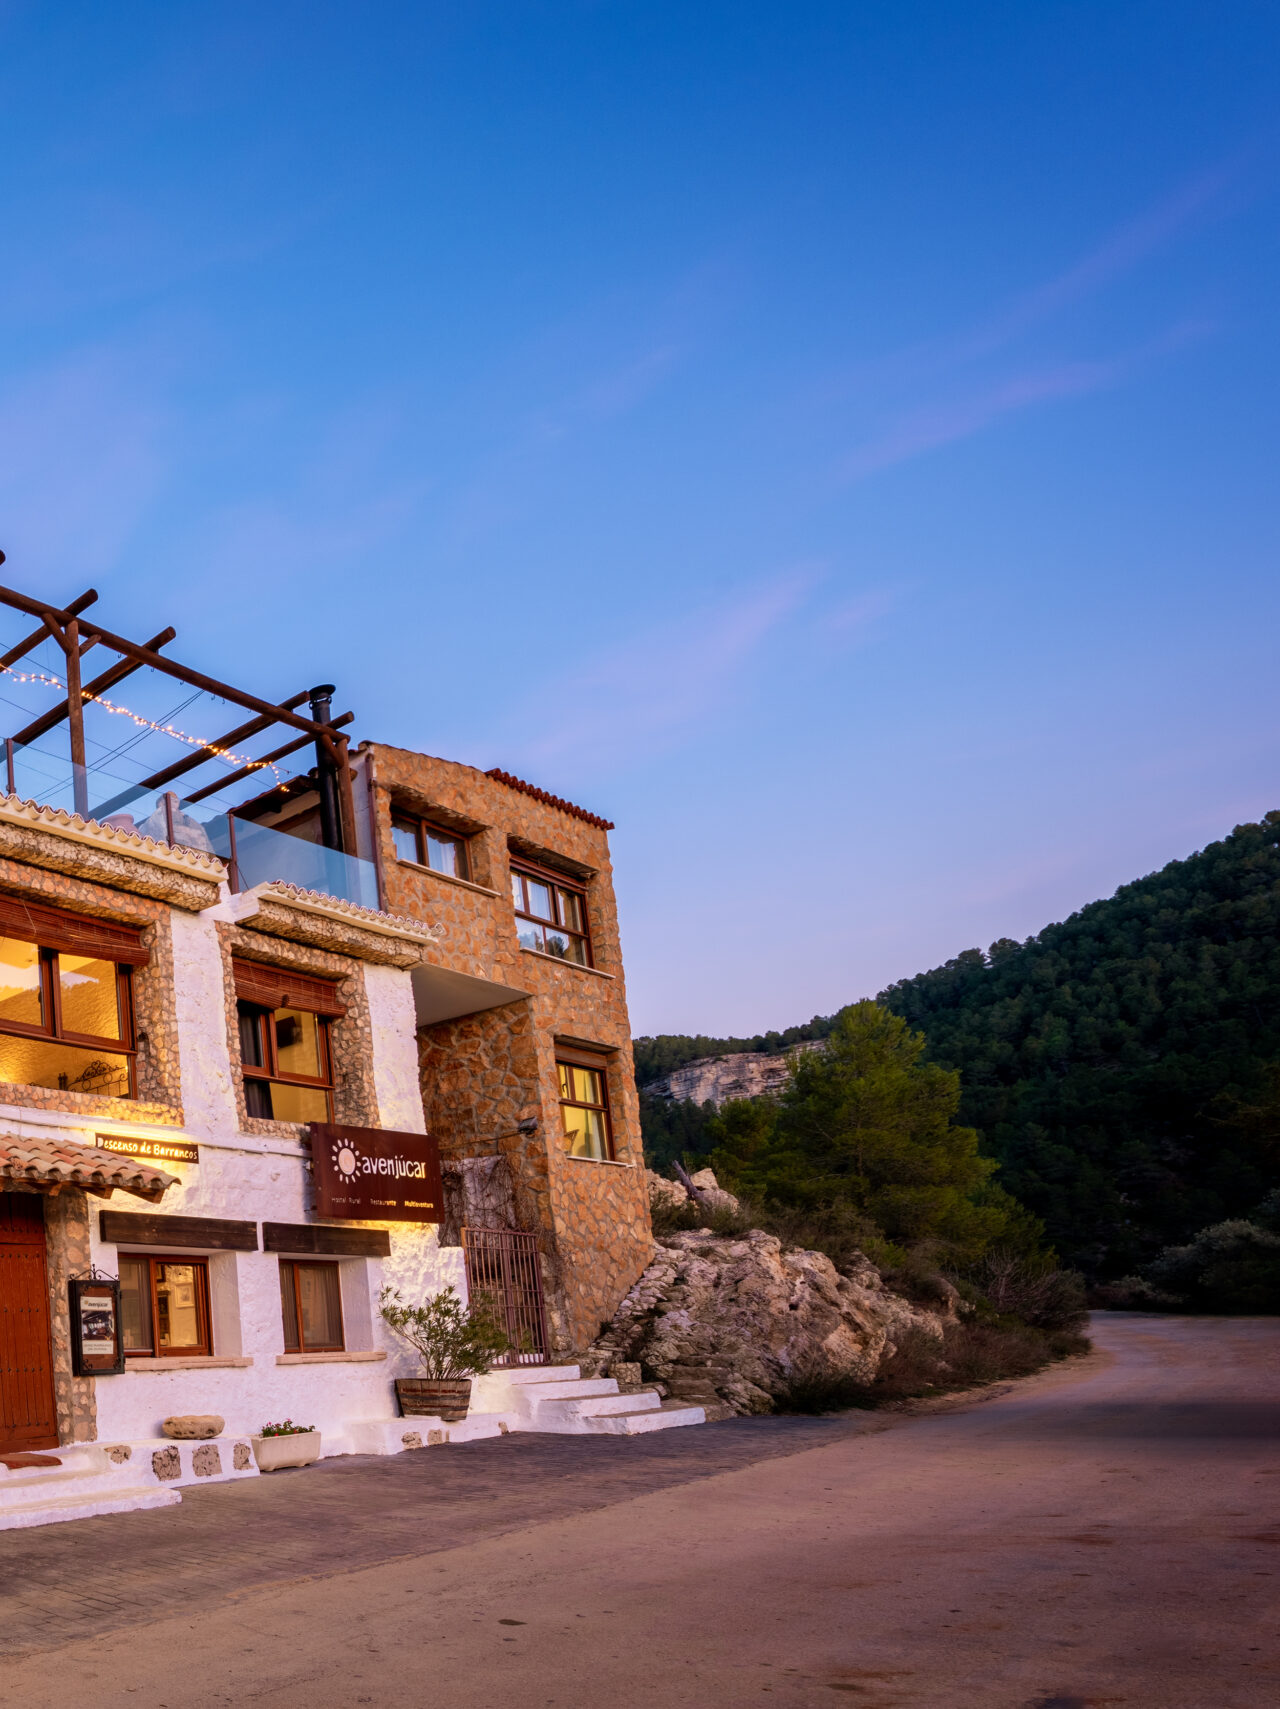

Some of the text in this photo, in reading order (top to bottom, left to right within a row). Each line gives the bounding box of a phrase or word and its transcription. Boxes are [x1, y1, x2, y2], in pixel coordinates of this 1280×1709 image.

[97, 1137, 198, 1160] Descenso de Barrancos
[361, 1155, 427, 1179] avenjúcar
